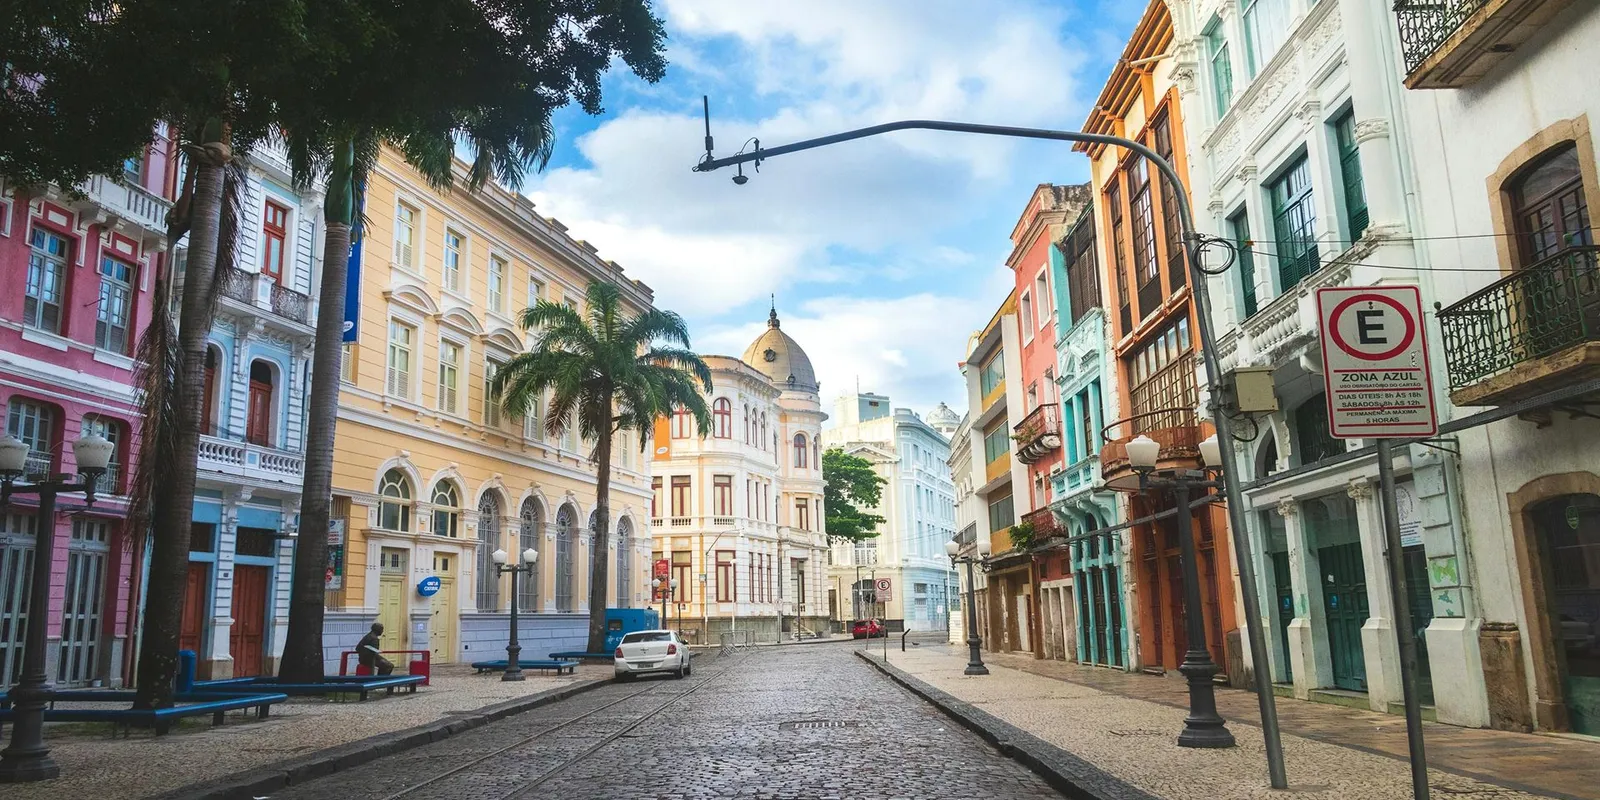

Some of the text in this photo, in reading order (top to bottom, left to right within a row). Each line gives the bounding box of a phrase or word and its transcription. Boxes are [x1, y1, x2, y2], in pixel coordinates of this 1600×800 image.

[1356, 310, 1388, 345] E
[1341, 372, 1418, 382] ZONA AZUL
